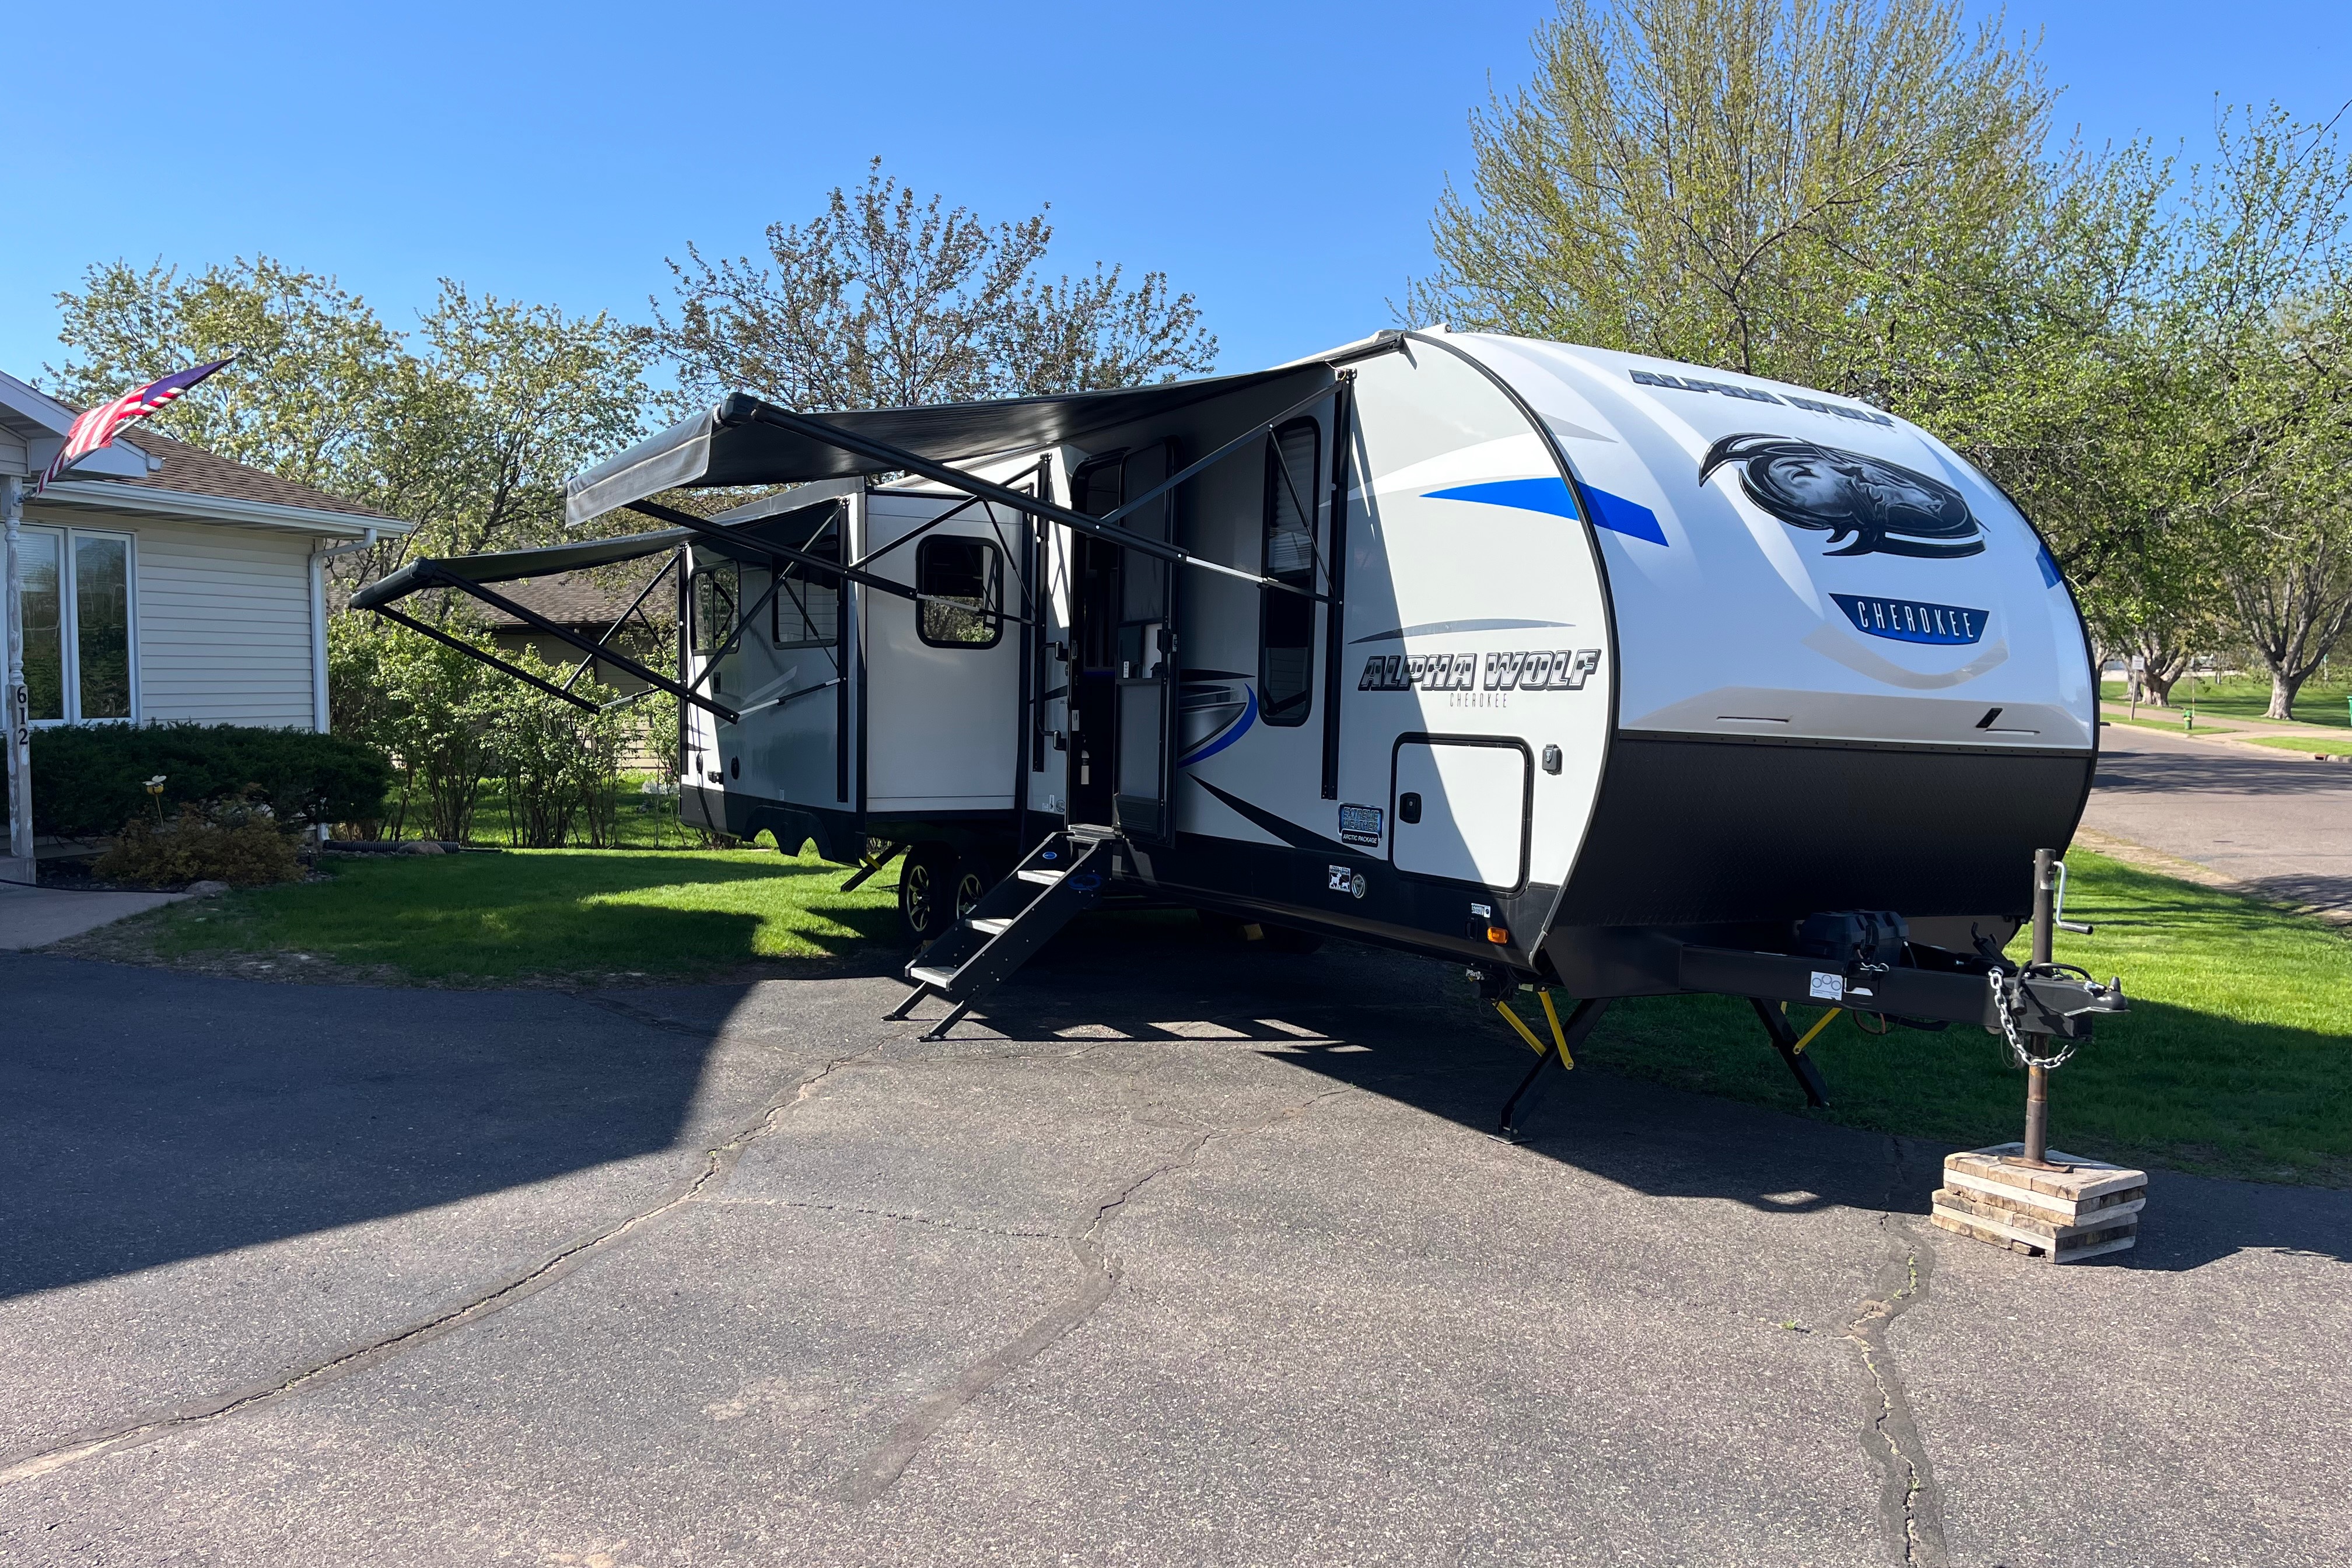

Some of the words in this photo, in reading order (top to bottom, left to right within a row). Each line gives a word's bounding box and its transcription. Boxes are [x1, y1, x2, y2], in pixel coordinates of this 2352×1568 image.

[1628, 369, 1787, 406] ALPHA
[1778, 393, 1896, 428] WOLF
[1857, 601, 1974, 638] CHEROKEE
[1357, 653, 1478, 691] ALPHA
[1483, 649, 1602, 691] WOLF
[17, 685, 28, 745] 612
[1449, 692, 1507, 708] CHEROKEE
[1343, 807, 1379, 821] EXTREME
[1343, 818, 1377, 831] WEATHER
